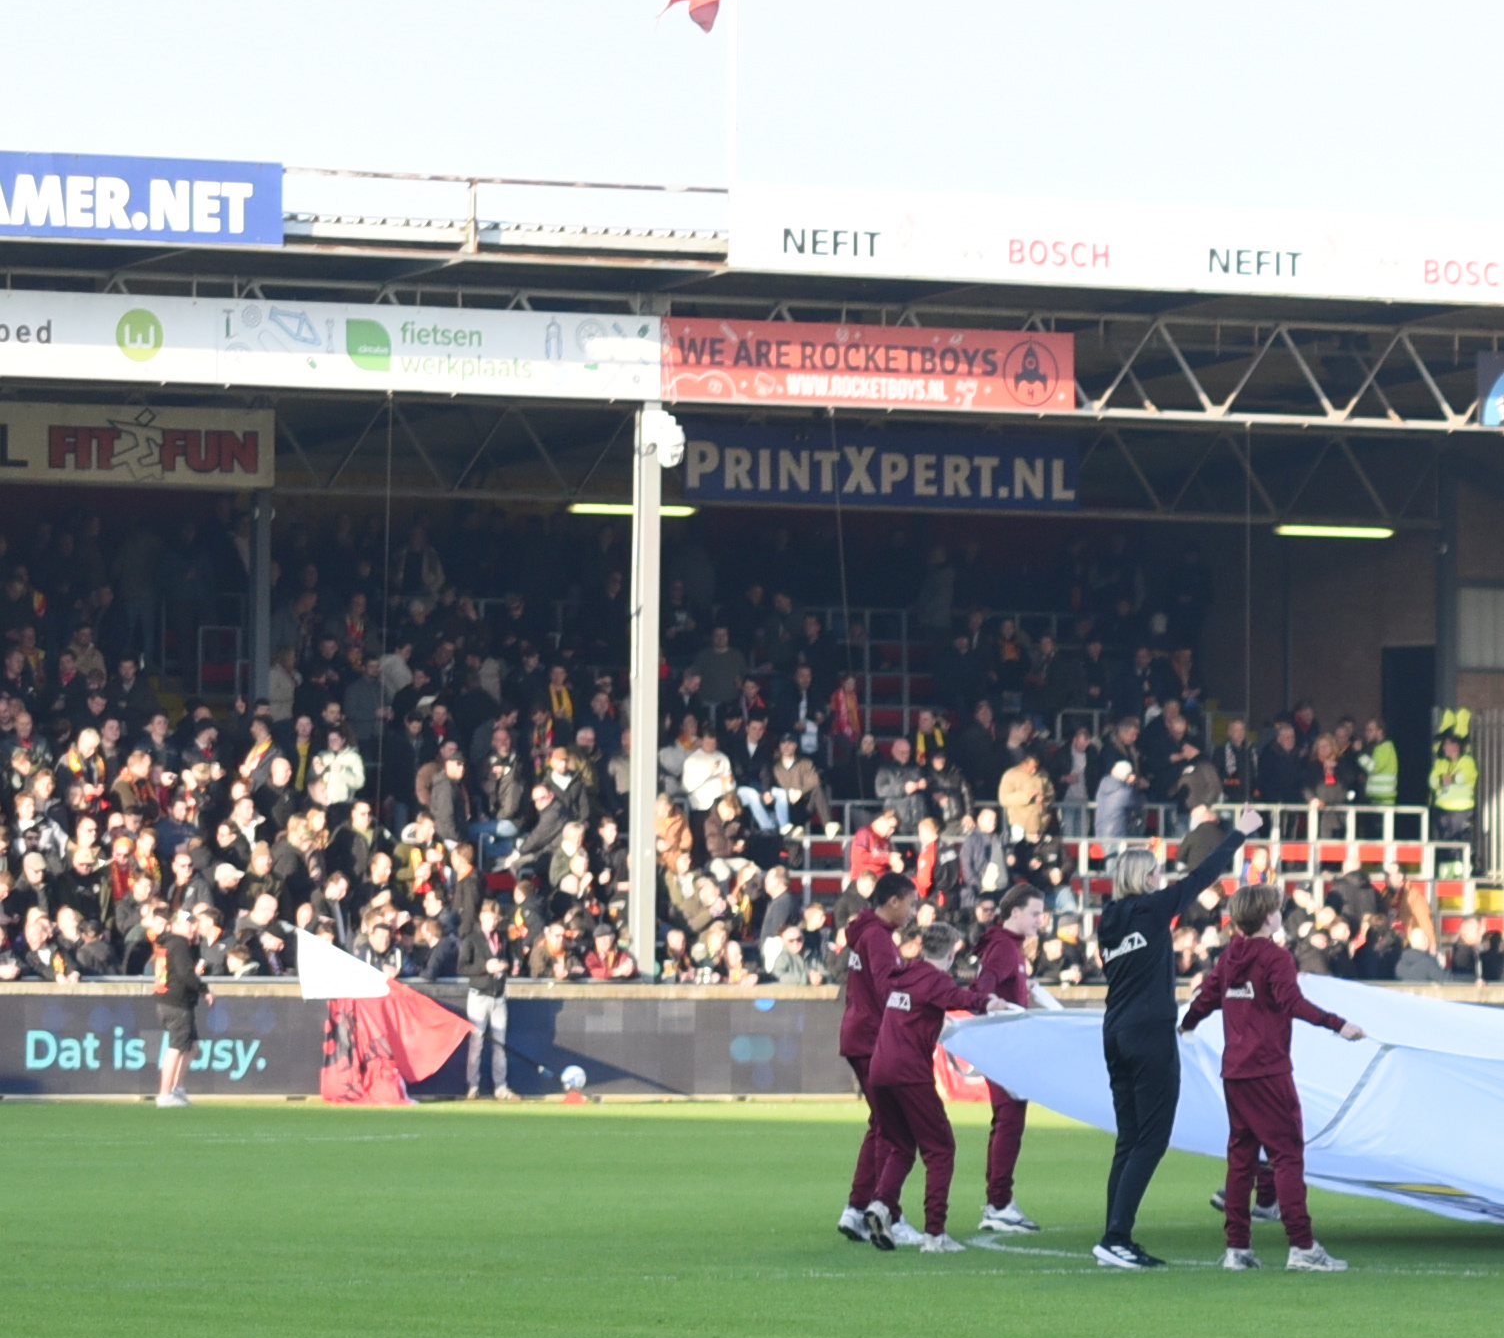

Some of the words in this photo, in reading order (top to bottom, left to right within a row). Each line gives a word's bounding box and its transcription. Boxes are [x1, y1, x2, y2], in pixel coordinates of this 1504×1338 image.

[783, 228, 881, 258] NEFIT
[1008, 238, 1111, 269] BOSCH
[1209, 247, 1302, 277] NEFIT
[401, 321, 483, 348] fietsen
[400, 353, 533, 381] werkplaats
[678, 337, 725, 368] WE
[733, 340, 791, 370] ARE
[801, 341, 999, 377] ROCKETBOYS
[786, 372, 948, 403] WWW.ROCKETBOYS.NL
[158, 430, 259, 473] FUN
[25, 1029, 101, 1071] Dat
[113, 1026, 146, 1071] is
[158, 1030, 267, 1081] asy.
